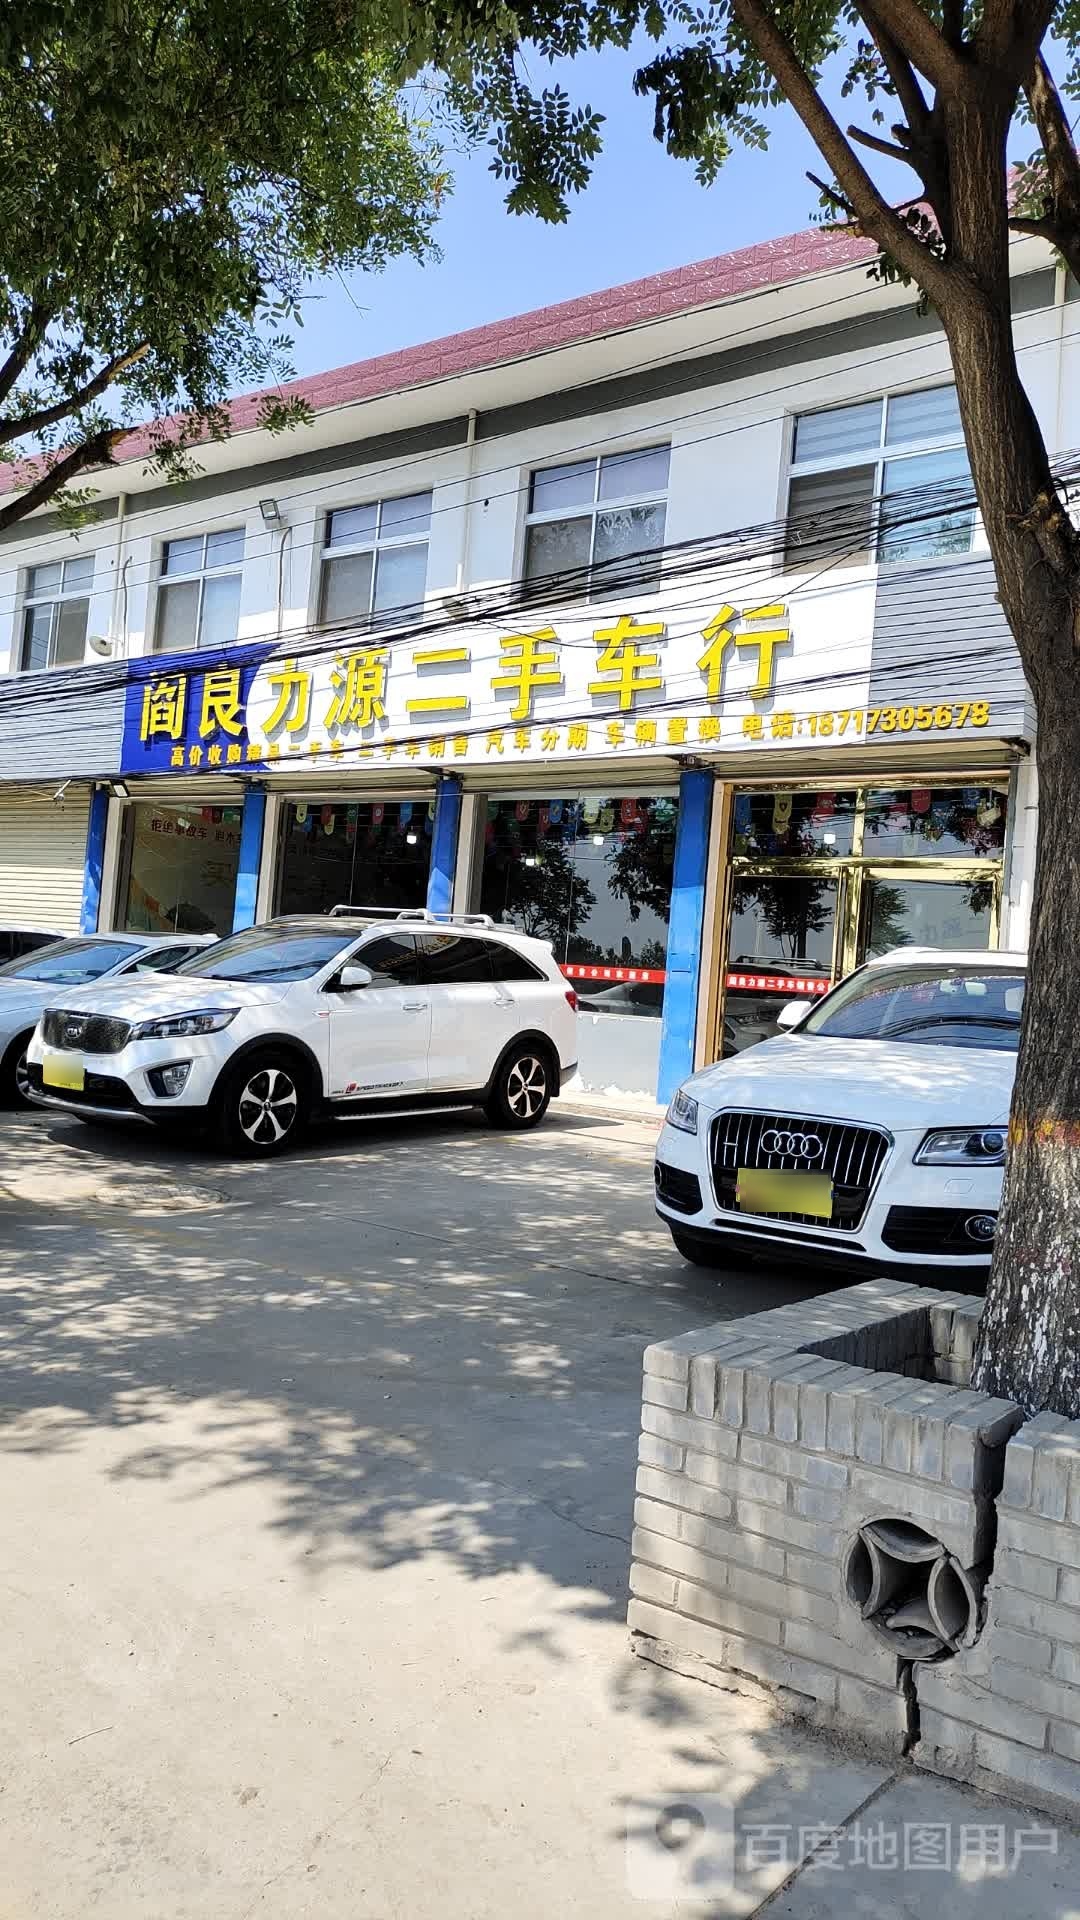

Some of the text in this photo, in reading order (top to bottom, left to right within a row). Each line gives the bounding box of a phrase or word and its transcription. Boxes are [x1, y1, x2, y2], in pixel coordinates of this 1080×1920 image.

[139, 603, 791, 742] 阎良力源二手车行
[486, 722, 589, 755] 汽车分期
[605, 716, 722, 749] 车辆置换
